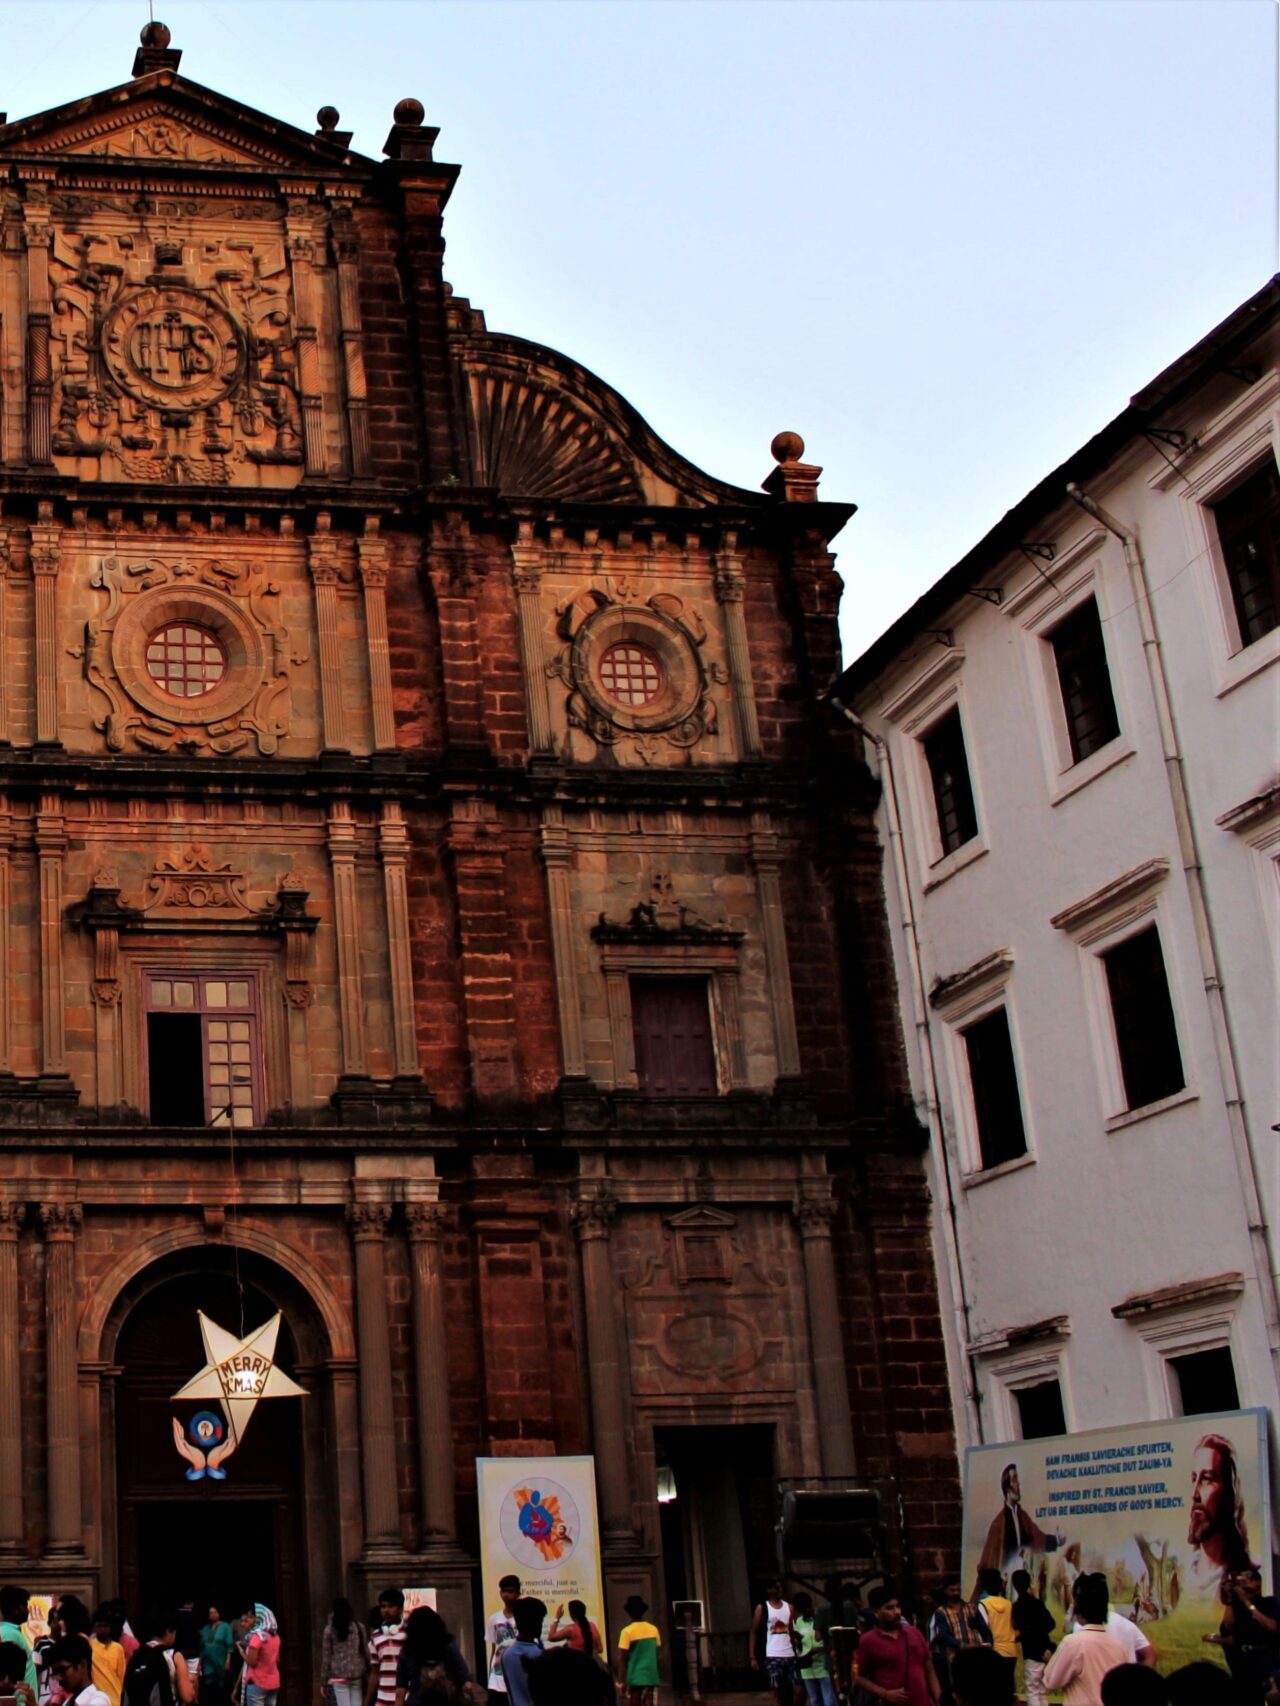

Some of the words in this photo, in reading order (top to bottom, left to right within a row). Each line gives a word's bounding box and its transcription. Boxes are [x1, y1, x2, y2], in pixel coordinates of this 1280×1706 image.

[220, 1356, 272, 1379] MERRY
[222, 1378, 263, 1395] X'MAS
[1046, 1455, 1060, 1465] SAM
[1093, 1446, 1135, 1460] XAVIERACHE
[1047, 1469, 1077, 1480] DEVACHE
[1049, 1491, 1080, 1502] INSPIRED
[1082, 1490, 1091, 1499] BY
[1093, 1488, 1102, 1498] ST.
[1105, 1486, 1136, 1497] FRANCIS
[1138, 1482, 1167, 1494] XAVIER,
[1035, 1507, 1047, 1517] LET
[1048, 1507, 1057, 1516] US
[1059, 1506, 1067, 1516] BE
[1070, 1502, 1116, 1515] MESSENGERS
[1119, 1502, 1128, 1512] OF
[1130, 1500, 1152, 1510] GOD'S
[1155, 1497, 1184, 1509] MERCY.
[556, 1579, 568, 1587] just
